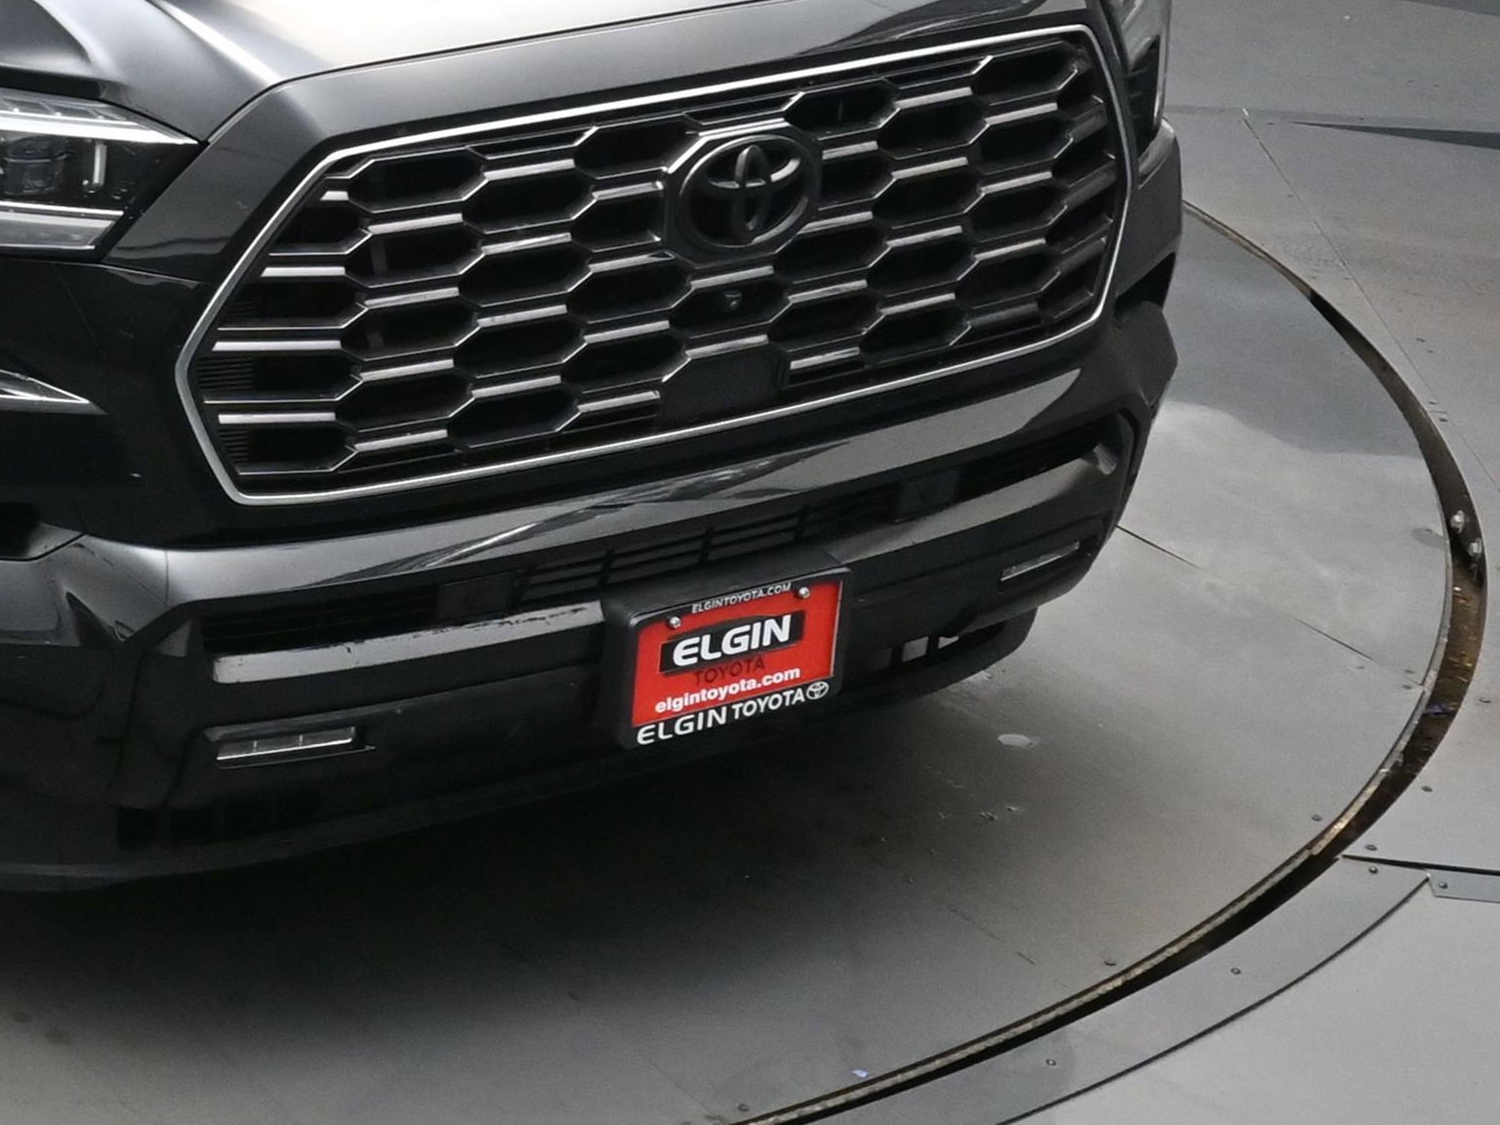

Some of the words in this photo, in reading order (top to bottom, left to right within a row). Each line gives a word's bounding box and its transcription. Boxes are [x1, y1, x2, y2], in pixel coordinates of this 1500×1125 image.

[691, 582, 792, 614] ELGINTOYOTA.COM
[672, 614, 792, 667] ELGIN
[655, 668, 801, 713] elgintoyota.com
[693, 655, 766, 686] TOYOTA
[636, 706, 727, 745] ELGIN
[731, 688, 806, 720] TOYOTA
